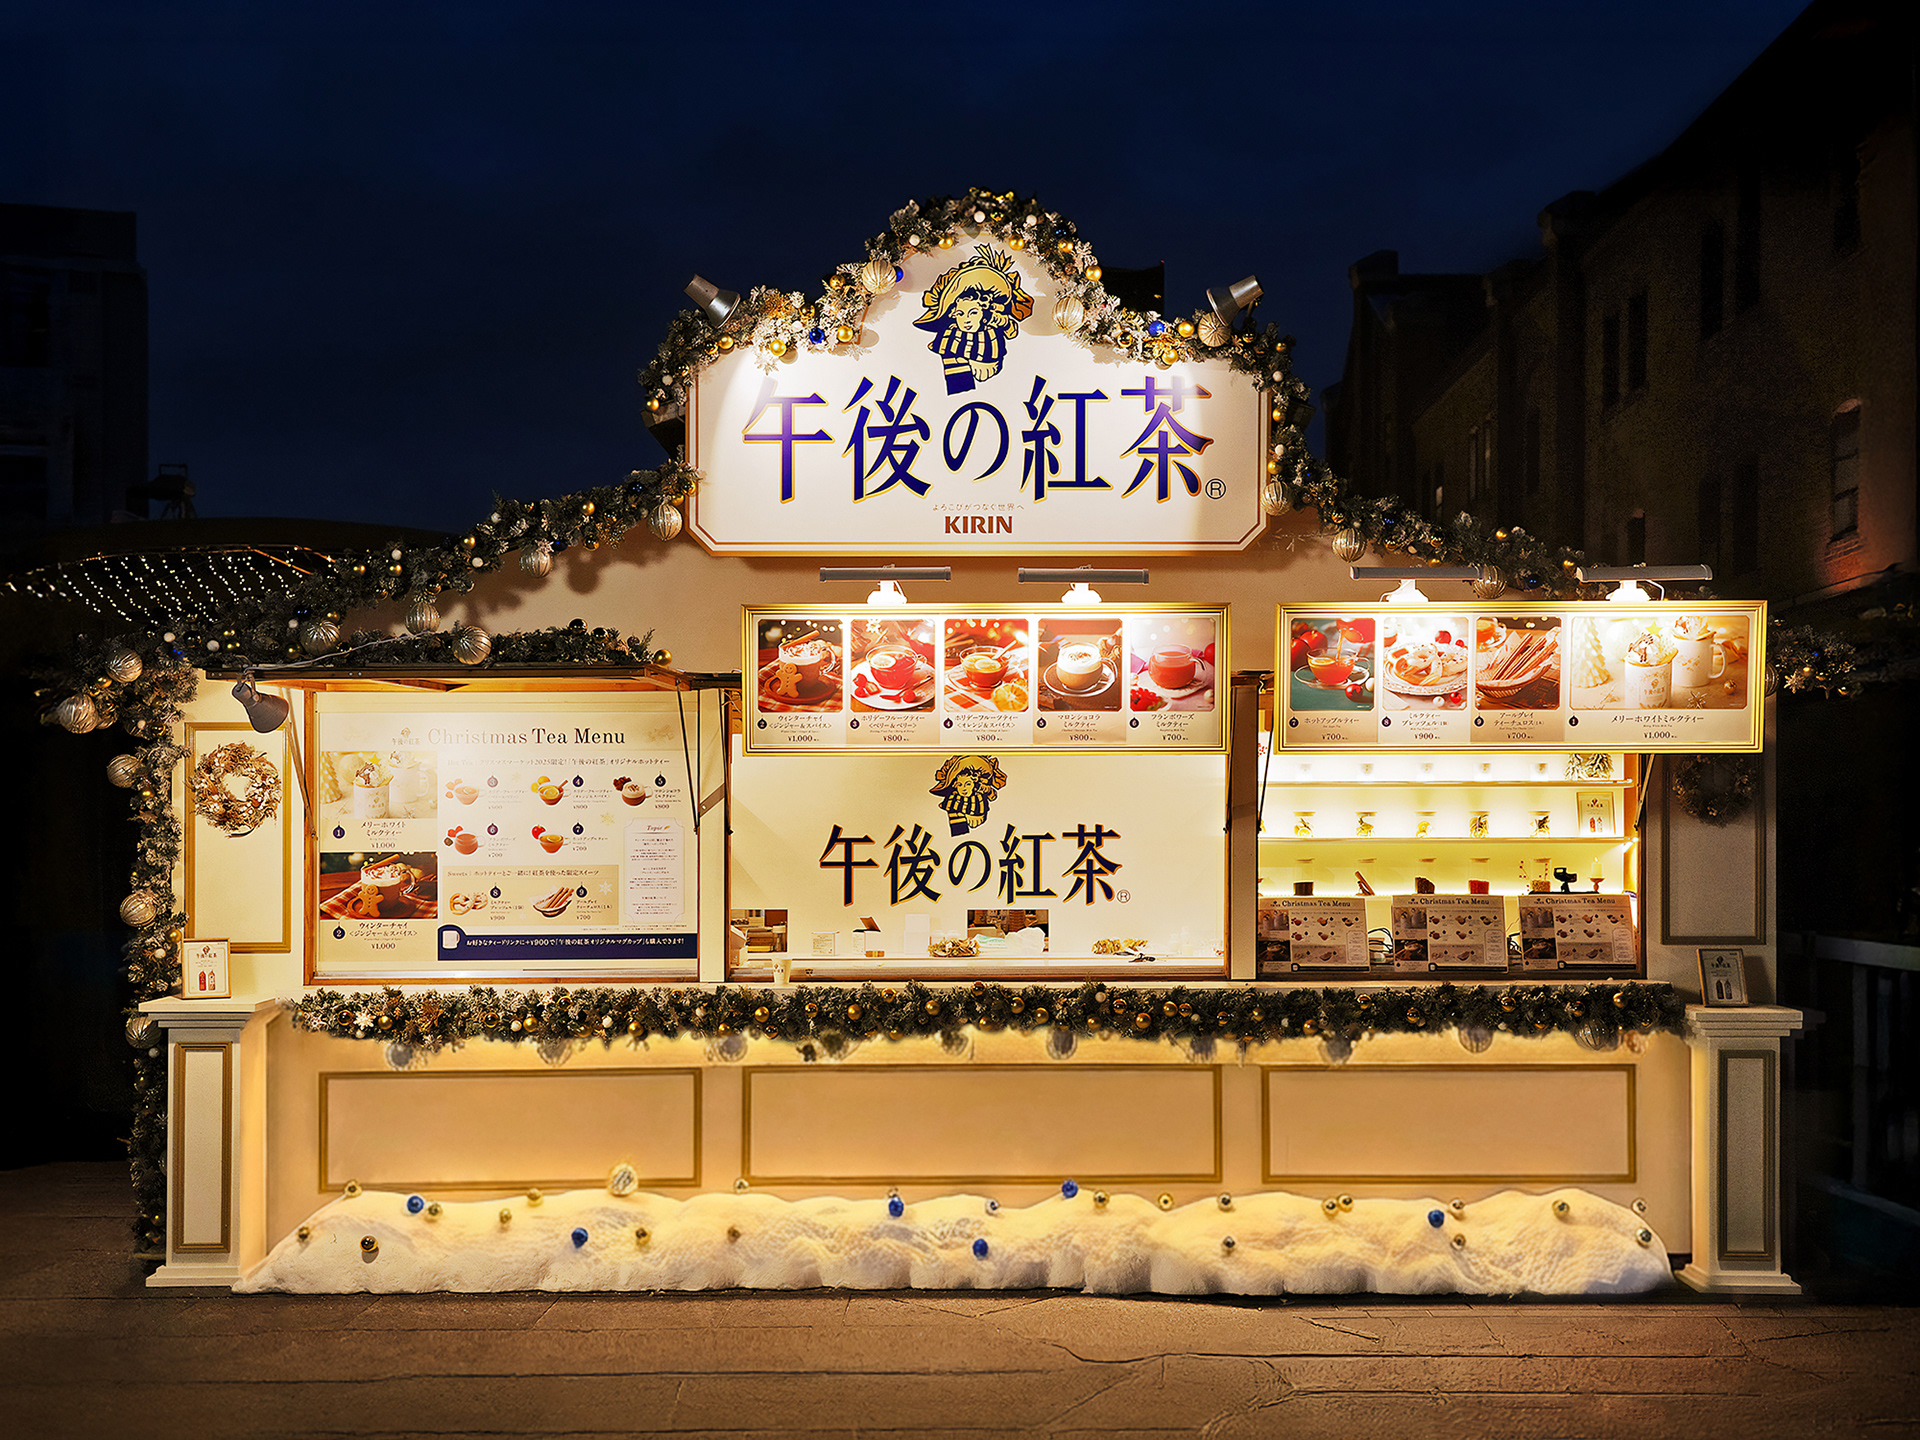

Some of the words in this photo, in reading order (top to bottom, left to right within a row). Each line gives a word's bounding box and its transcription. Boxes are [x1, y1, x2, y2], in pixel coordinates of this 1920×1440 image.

[742, 374, 1214, 504] 午後の紅茶
[932, 503, 1025, 511] よろこびがつなぐ世界へ
[944, 515, 1013, 534] KIRIN
[1611, 715, 1705, 723] メリーホワイトミルクティー
[427, 728, 528, 745] Christmas
[532, 728, 568, 744] Tea
[574, 728, 626, 744] Menu
[361, 821, 406, 829] メリーホワイト
[366, 829, 402, 837] ミルクティー
[819, 823, 1123, 907] 午後の紅茶
